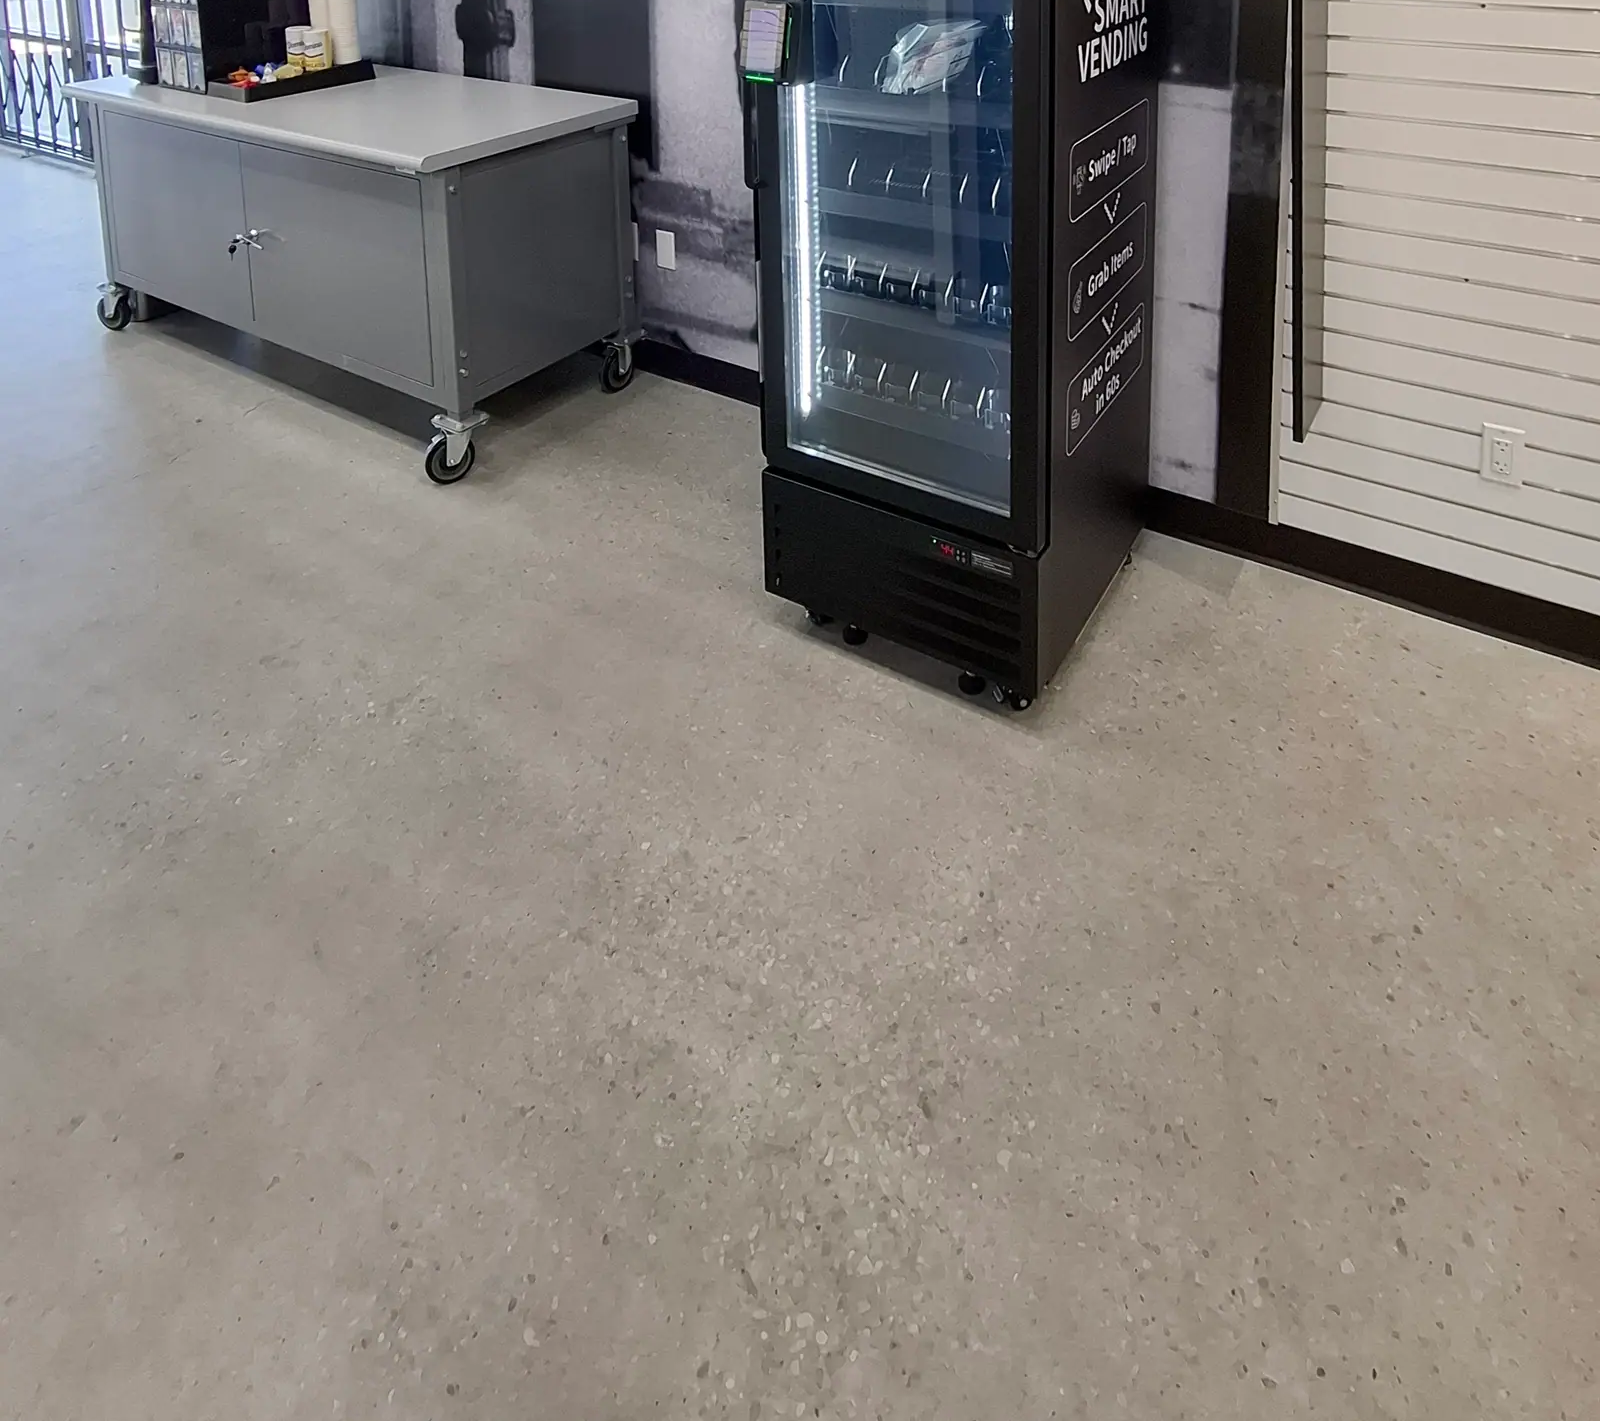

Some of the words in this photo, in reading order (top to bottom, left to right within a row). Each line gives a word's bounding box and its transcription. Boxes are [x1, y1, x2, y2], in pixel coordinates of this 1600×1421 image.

[1077, 16, 1148, 83] VENDING
[1087, 149, 1116, 182] Swipe
[1122, 133, 1137, 157] Tap
[1087, 261, 1110, 297] Grab
[1110, 241, 1134, 275] Items
[1081, 364, 1104, 401] Auto
[1104, 317, 1142, 373] Checkout
[1095, 393, 1105, 415] in
[1105, 373, 1120, 401] 60s
